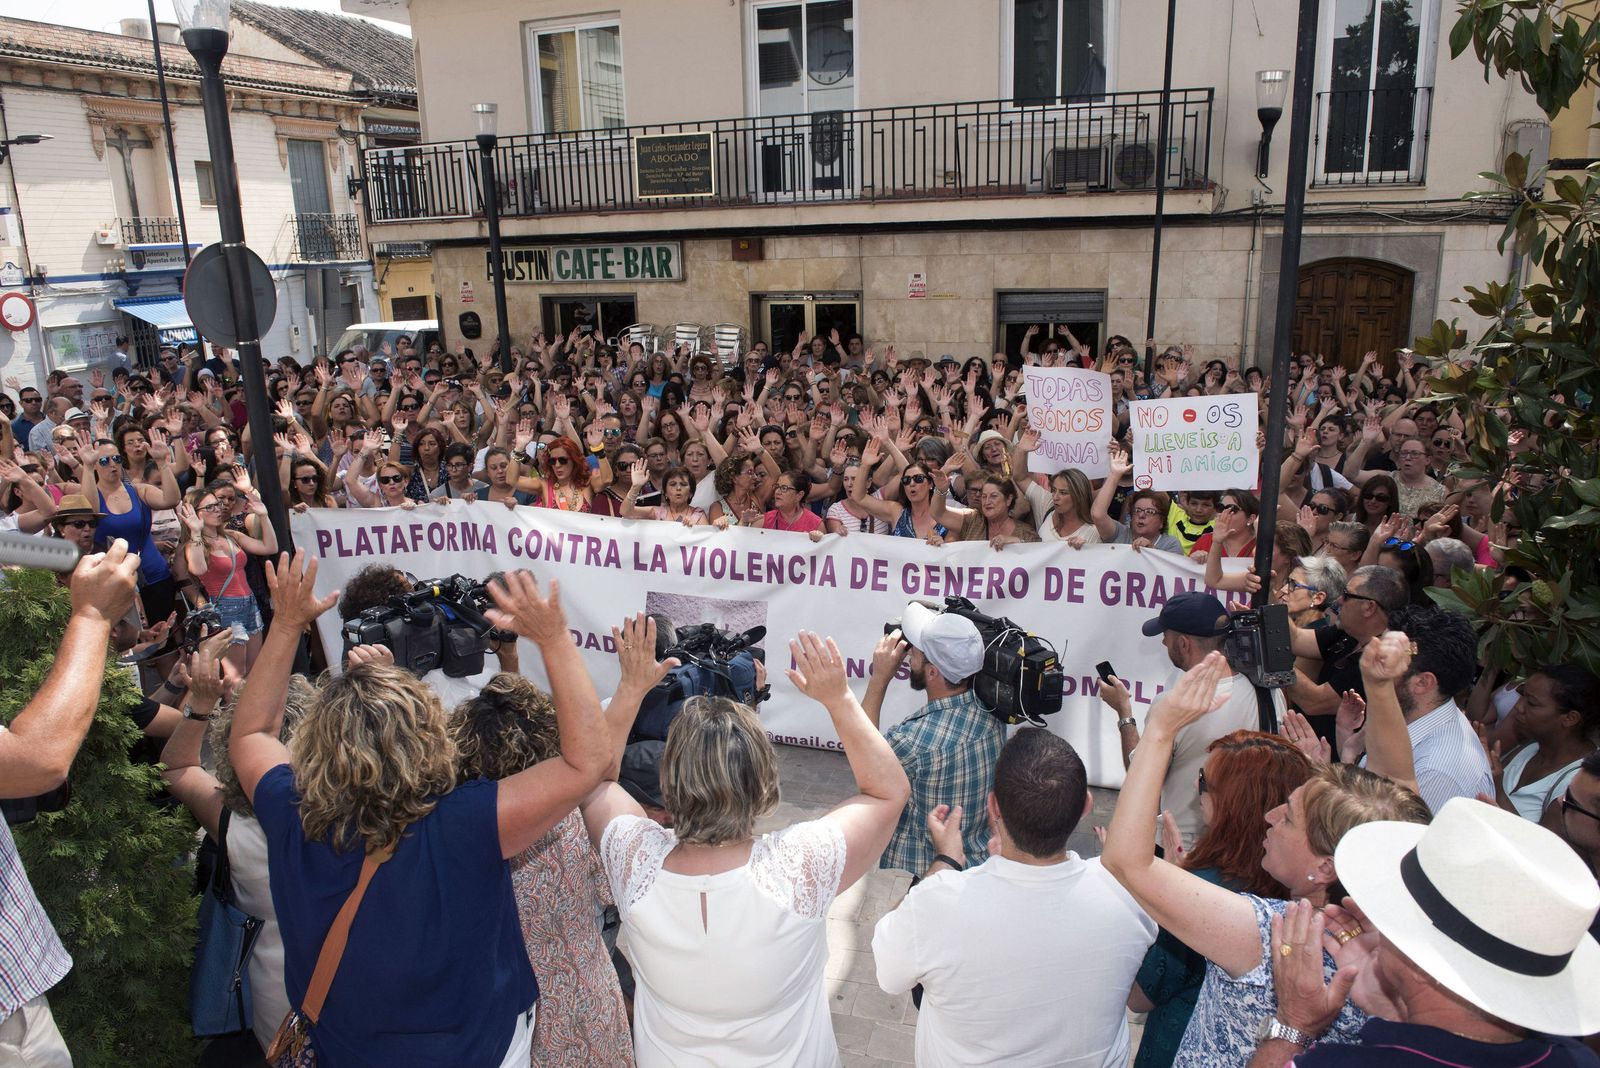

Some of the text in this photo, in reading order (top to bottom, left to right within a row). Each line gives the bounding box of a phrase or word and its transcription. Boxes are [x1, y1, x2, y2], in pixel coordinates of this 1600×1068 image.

[651, 153, 699, 163] ABOGADO
[556, 247, 673, 280] CAFE-BAR
[1027, 375, 1103, 402] TODAS
[1032, 407, 1104, 433] SOMOS
[1137, 403, 1242, 428] NO OS
[1035, 438, 1099, 464] JUANA
[1228, 431, 1241, 451] A
[316, 521, 497, 558] PLATAFORMA
[508, 526, 621, 568] CONTRA
[633, 541, 667, 573] LA
[680, 545, 837, 587] VIOLENCIA
[850, 557, 889, 592] DE
[901, 562, 1029, 601] GENERO
[1044, 567, 1086, 604] DE
